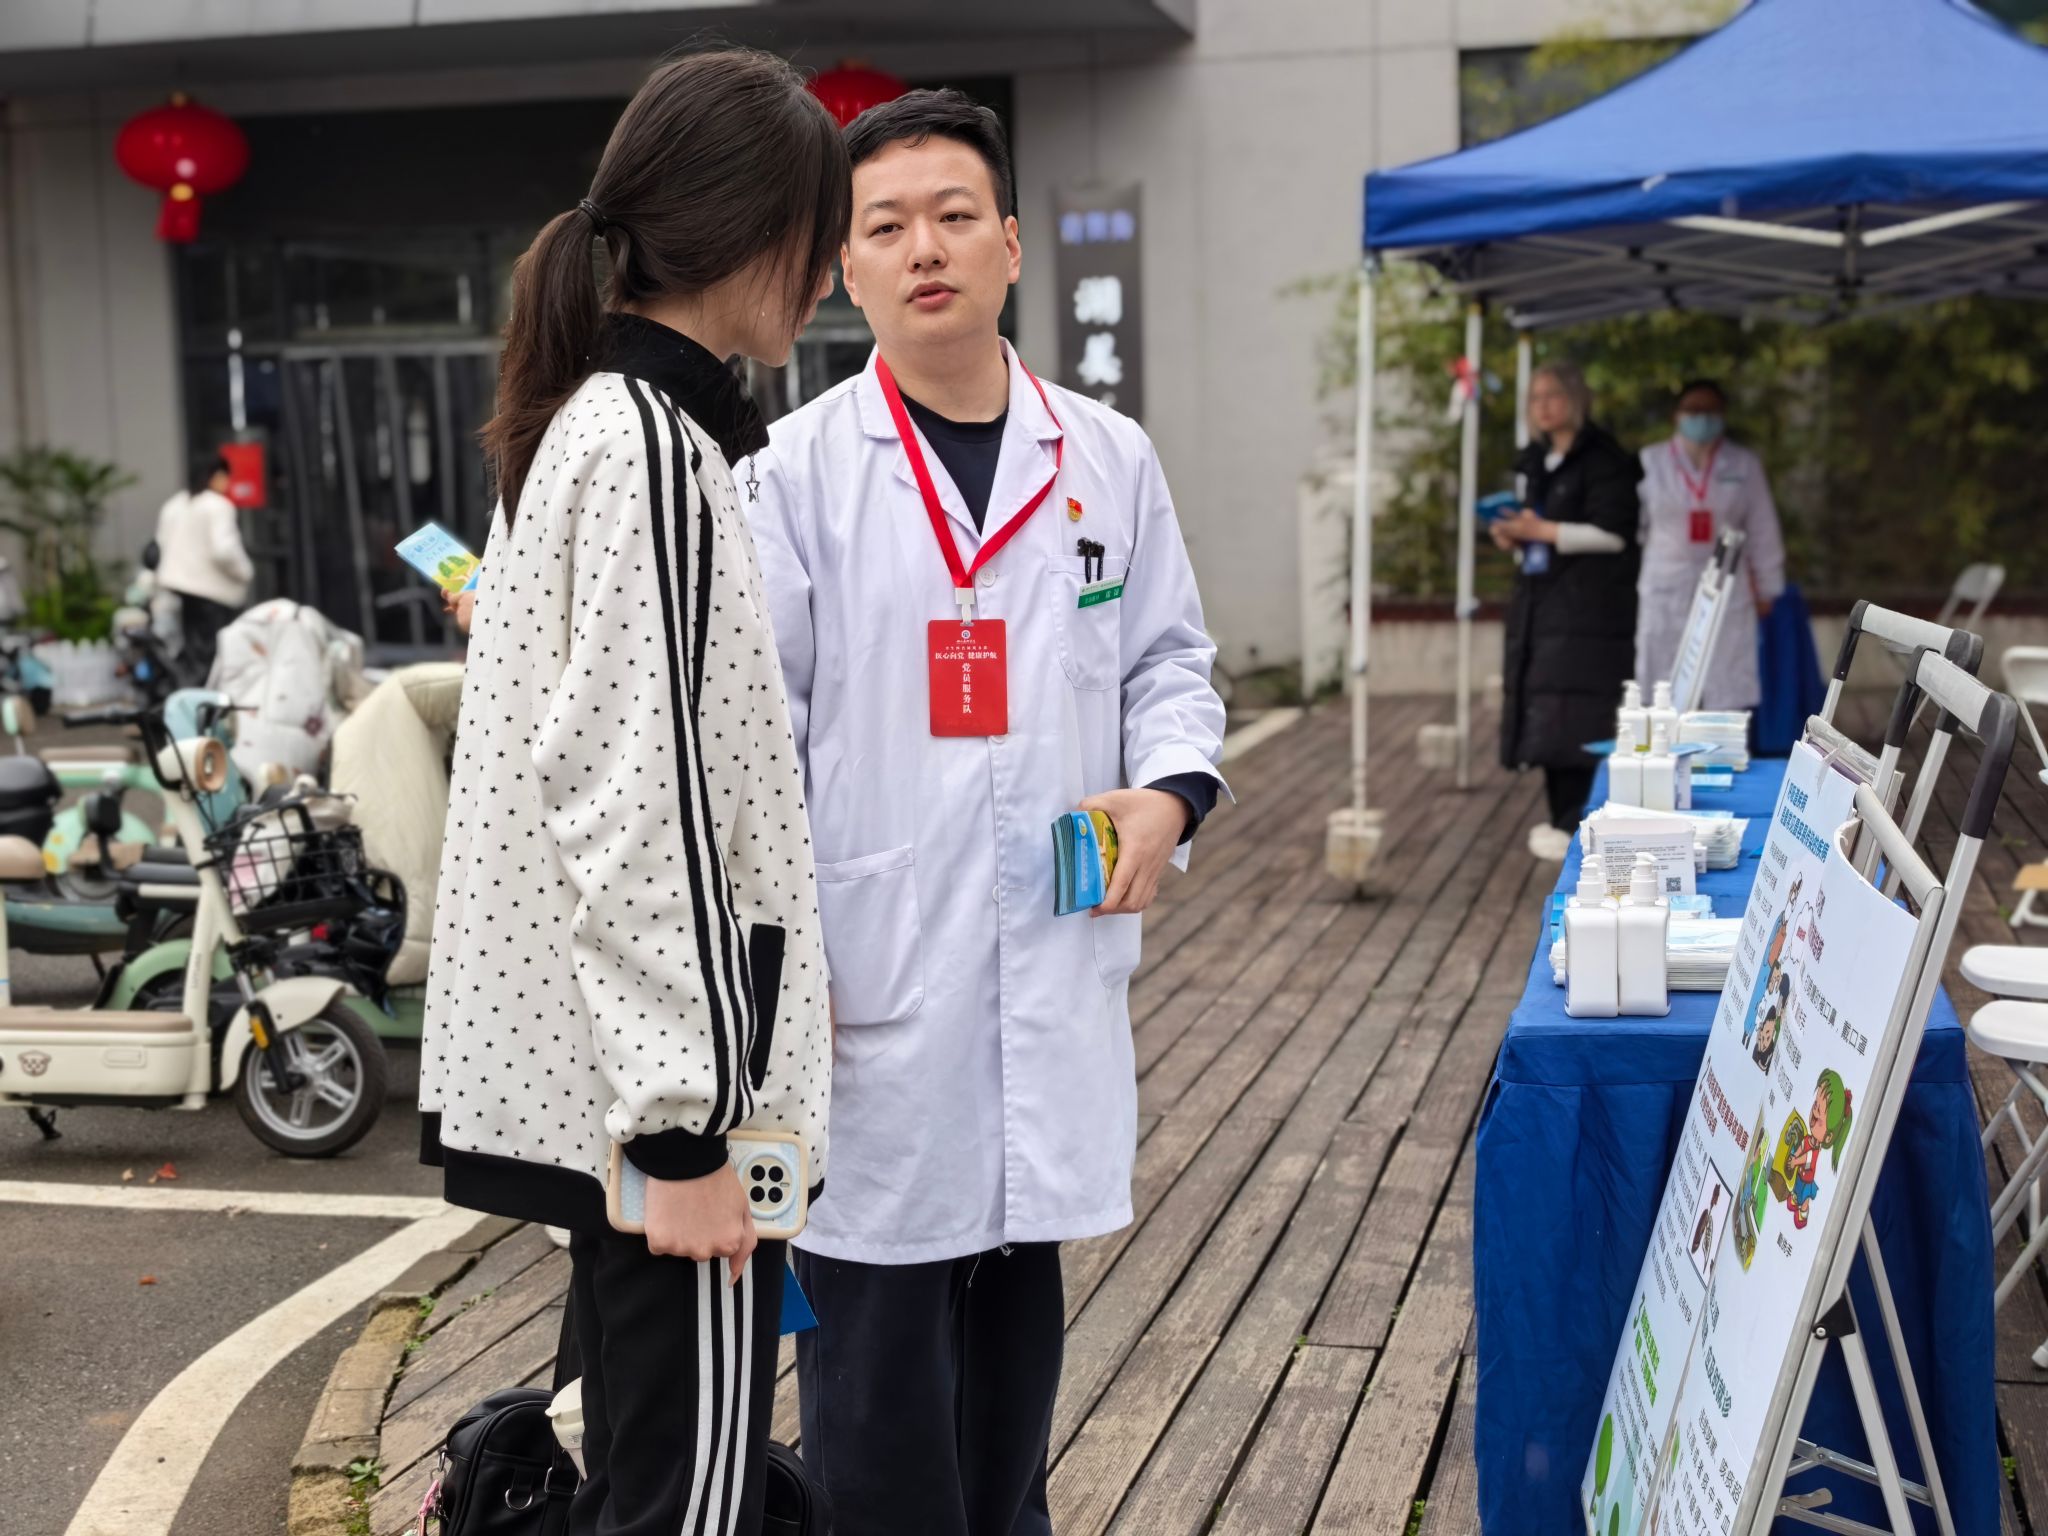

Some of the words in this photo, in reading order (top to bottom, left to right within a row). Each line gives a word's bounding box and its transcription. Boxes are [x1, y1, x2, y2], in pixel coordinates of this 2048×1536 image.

[961, 662, 972, 714] 党员服务队
